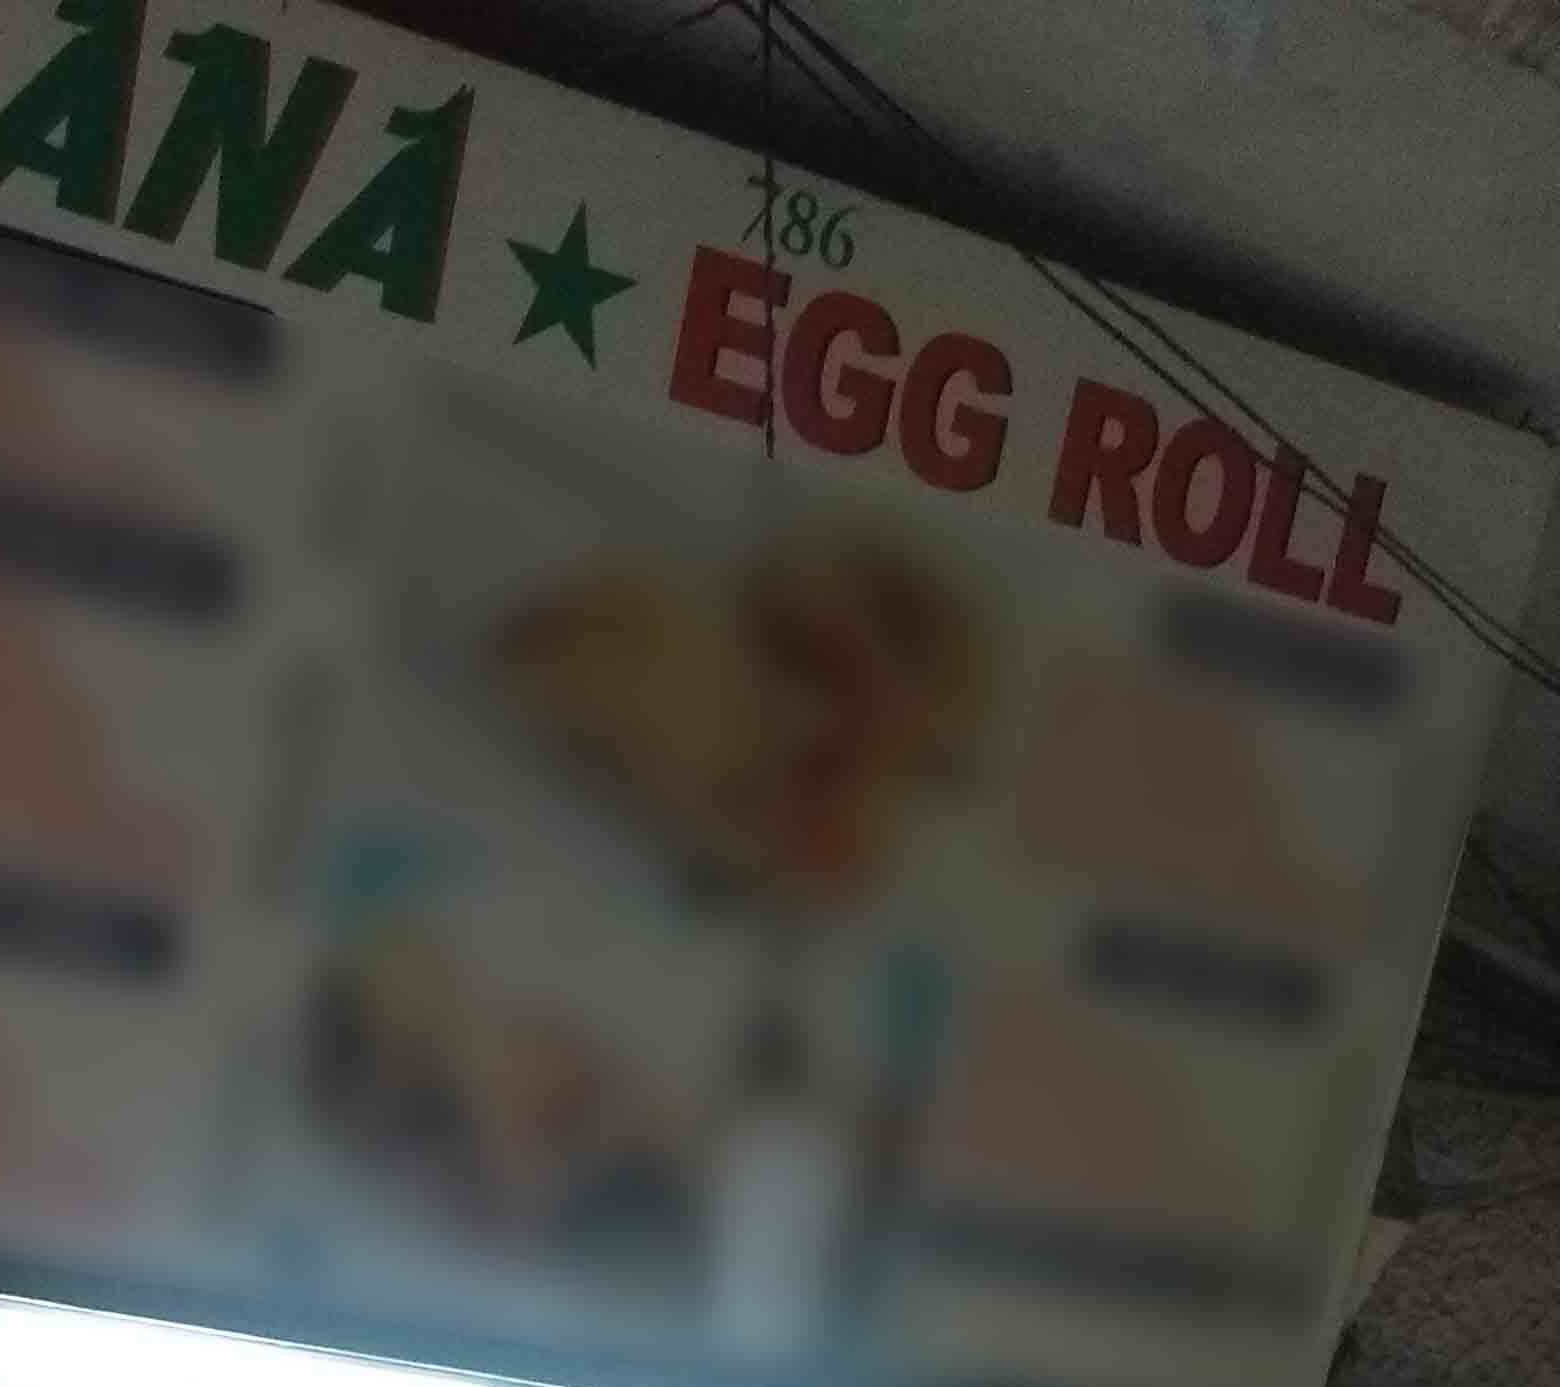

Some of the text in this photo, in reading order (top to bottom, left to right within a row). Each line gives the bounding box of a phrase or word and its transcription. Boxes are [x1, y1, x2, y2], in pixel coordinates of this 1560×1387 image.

[741, 174, 858, 269] 786
[667, 244, 1014, 493] EGG
[1047, 376, 1404, 626] ROLL
